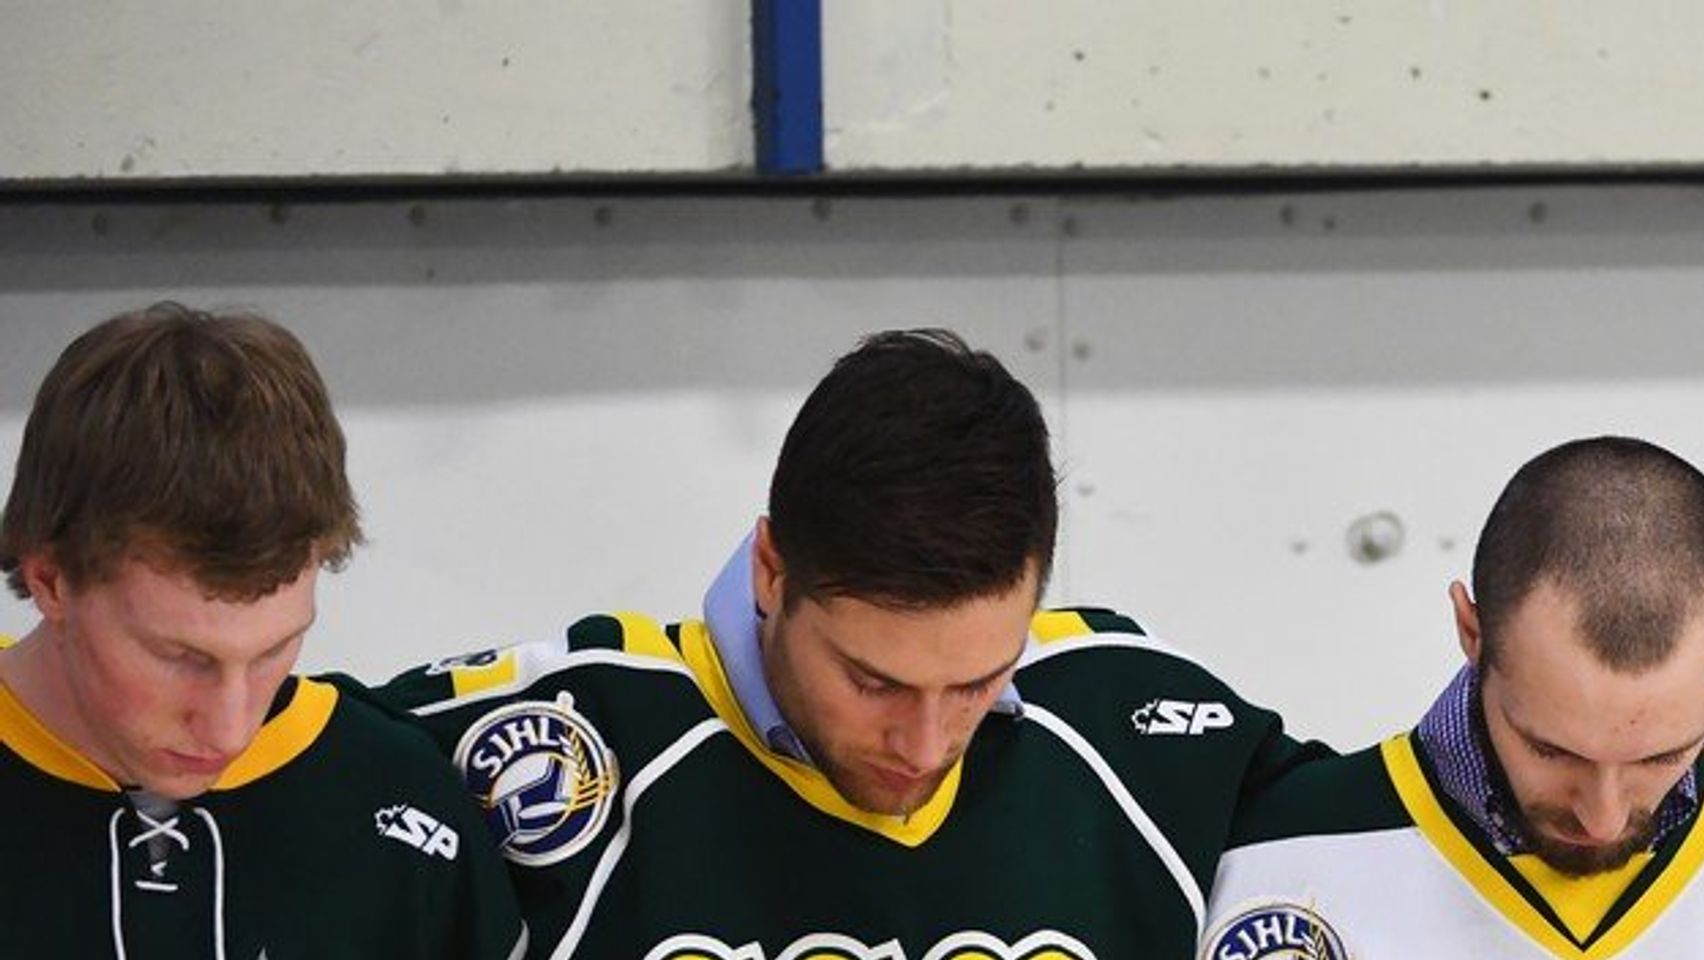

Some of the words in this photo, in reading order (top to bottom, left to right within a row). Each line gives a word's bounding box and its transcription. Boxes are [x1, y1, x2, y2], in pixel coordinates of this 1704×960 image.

[1147, 700, 1234, 735] SP
[472, 717, 560, 778] SJHL
[384, 806, 460, 860] SP
